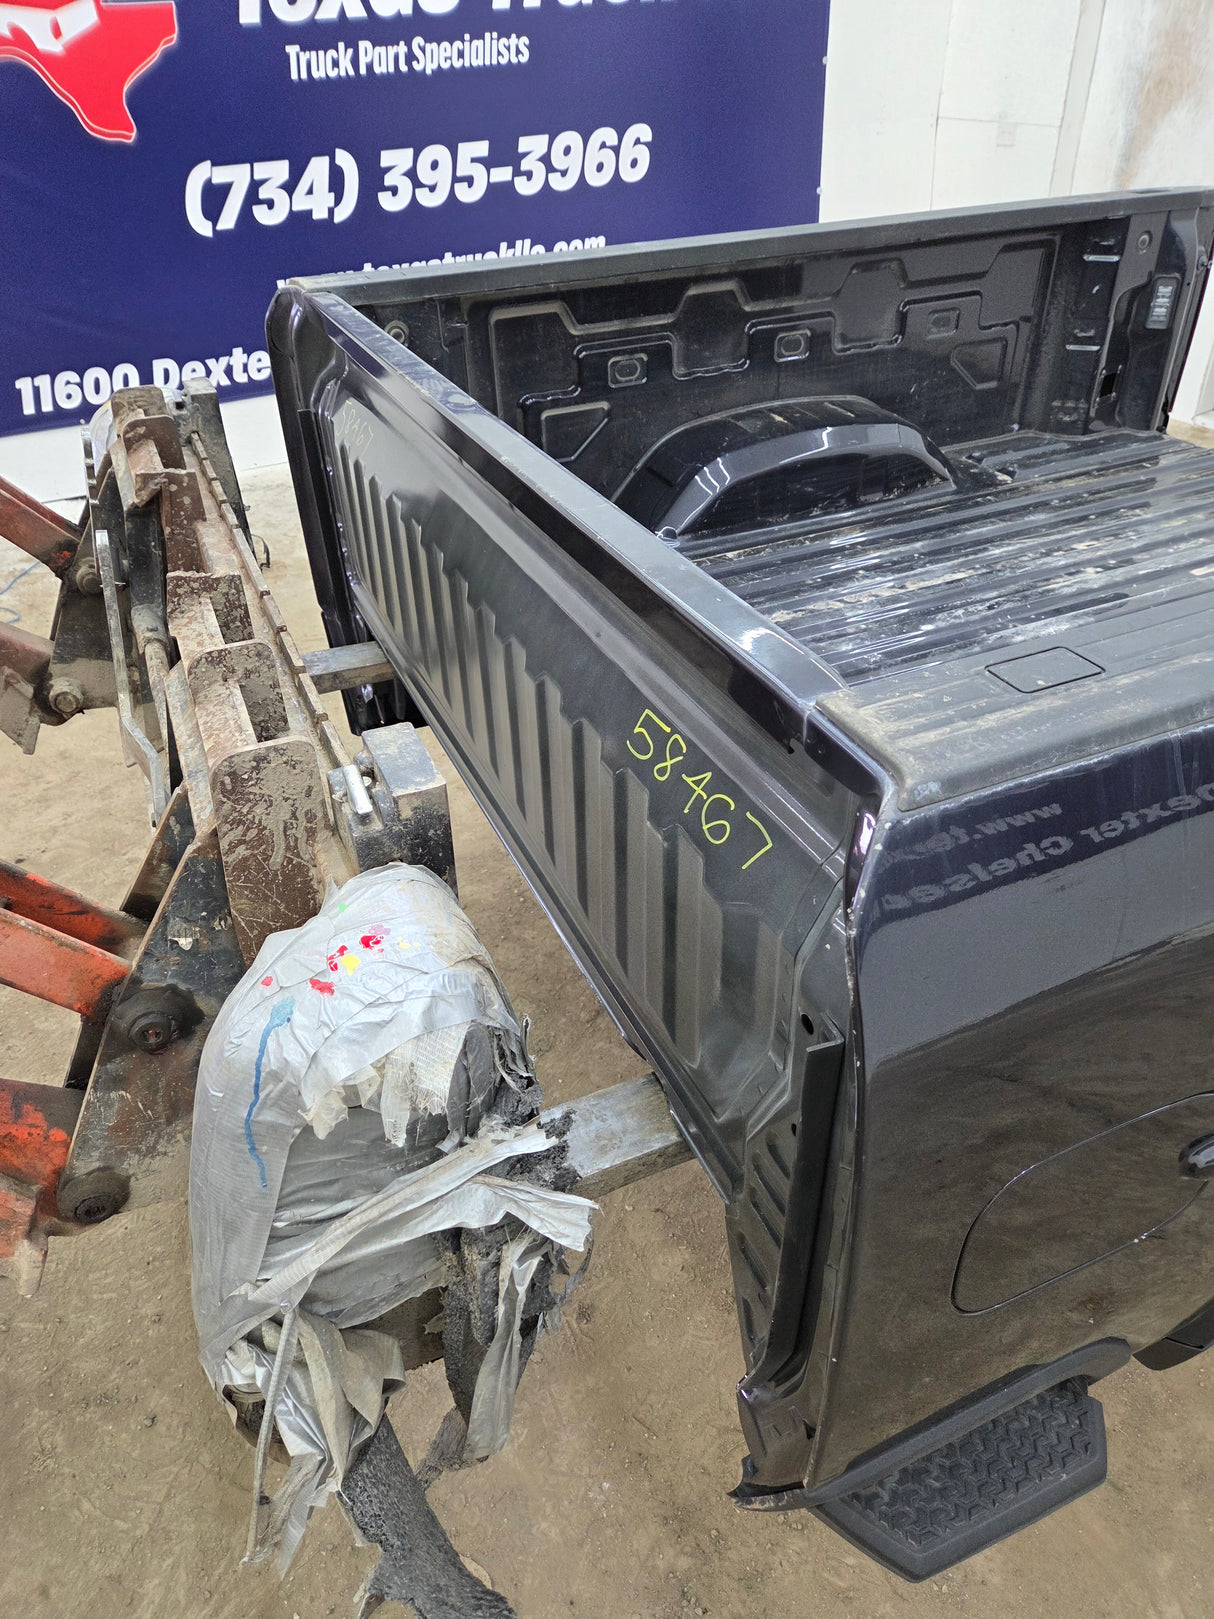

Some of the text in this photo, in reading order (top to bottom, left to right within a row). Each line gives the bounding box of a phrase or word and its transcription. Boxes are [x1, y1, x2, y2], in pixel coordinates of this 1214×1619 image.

[285, 31, 530, 82] Truck Part Specialists
[184, 123, 653, 238] (734) 395-3966
[14, 362, 140, 416] 11600
[626, 708, 773, 870] 58467
